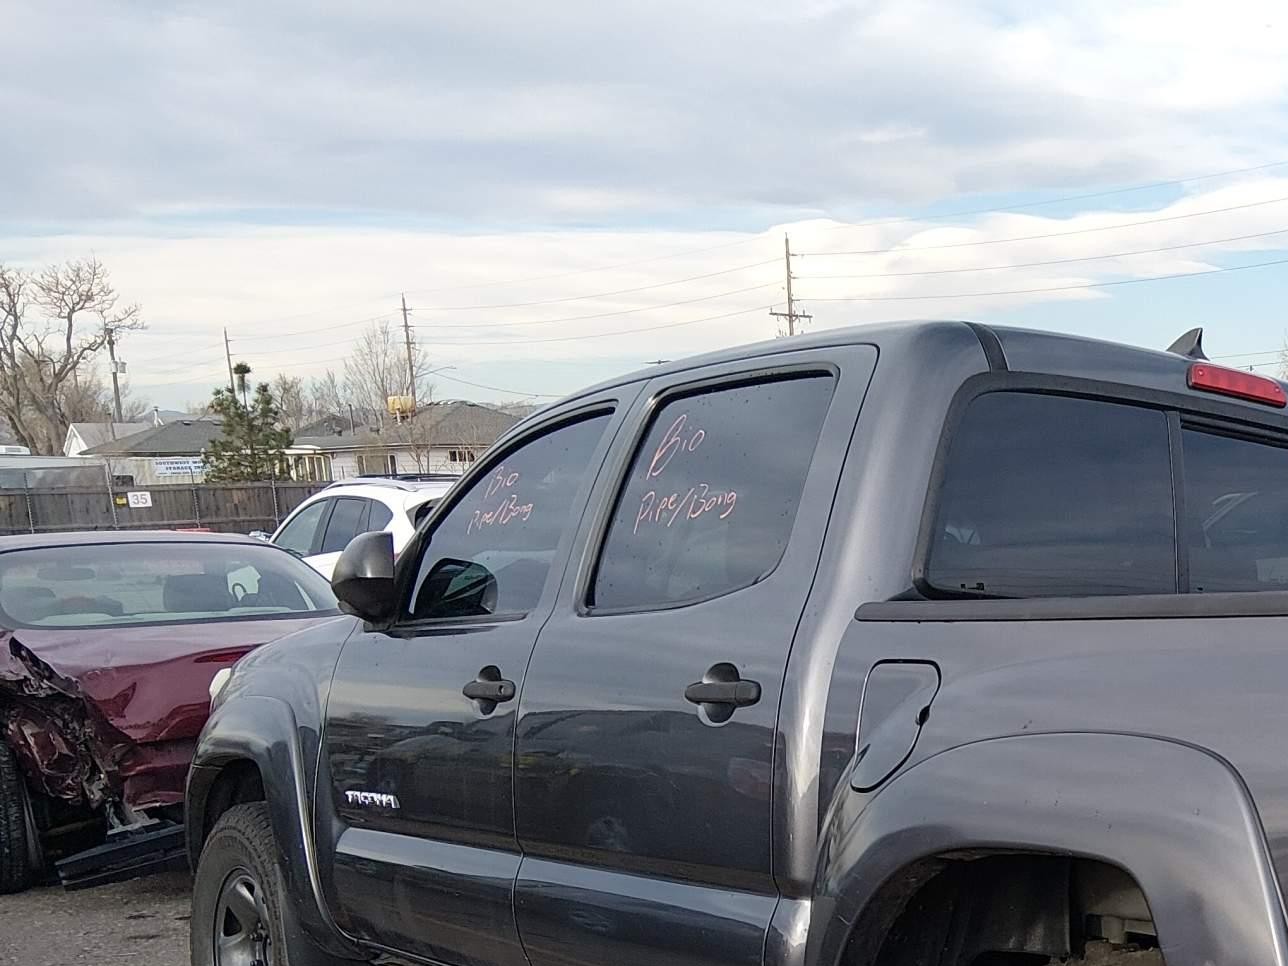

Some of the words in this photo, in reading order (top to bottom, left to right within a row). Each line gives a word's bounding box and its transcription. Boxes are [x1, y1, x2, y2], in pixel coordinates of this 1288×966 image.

[646, 414, 705, 480] Bio
[132, 494, 148, 505] 35
[633, 483, 737, 535] Pipe/Bong
